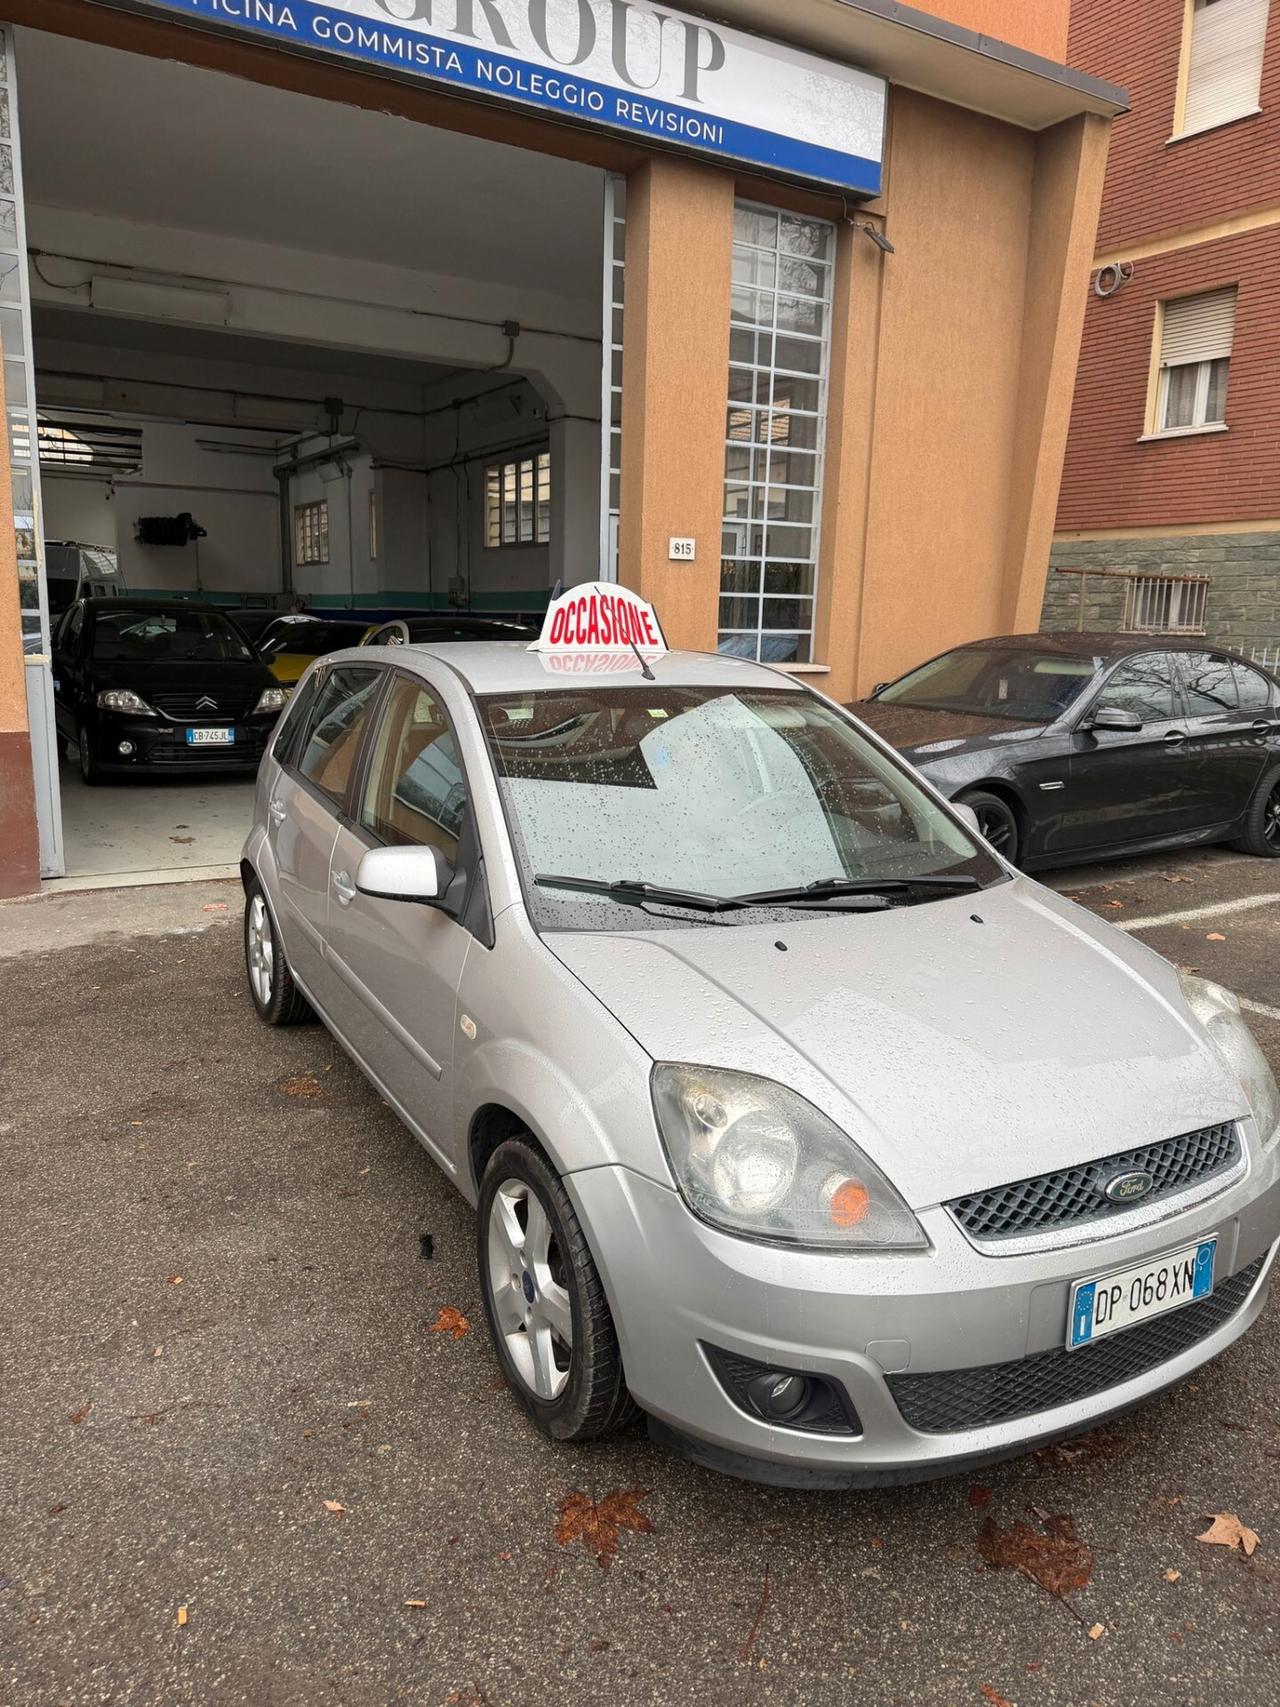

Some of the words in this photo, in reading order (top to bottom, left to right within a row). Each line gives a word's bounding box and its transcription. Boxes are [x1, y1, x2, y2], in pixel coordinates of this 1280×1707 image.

[312, 16, 463, 74] GOMMISTA
[476, 59, 604, 111] NOLEGGIO
[616, 99, 724, 144] REVISIONI
[673, 542, 692, 555] 815
[550, 594, 659, 646] OCCASIONE
[1119, 1177, 1145, 1197] Ford
[1095, 1285, 1122, 1325] DP
